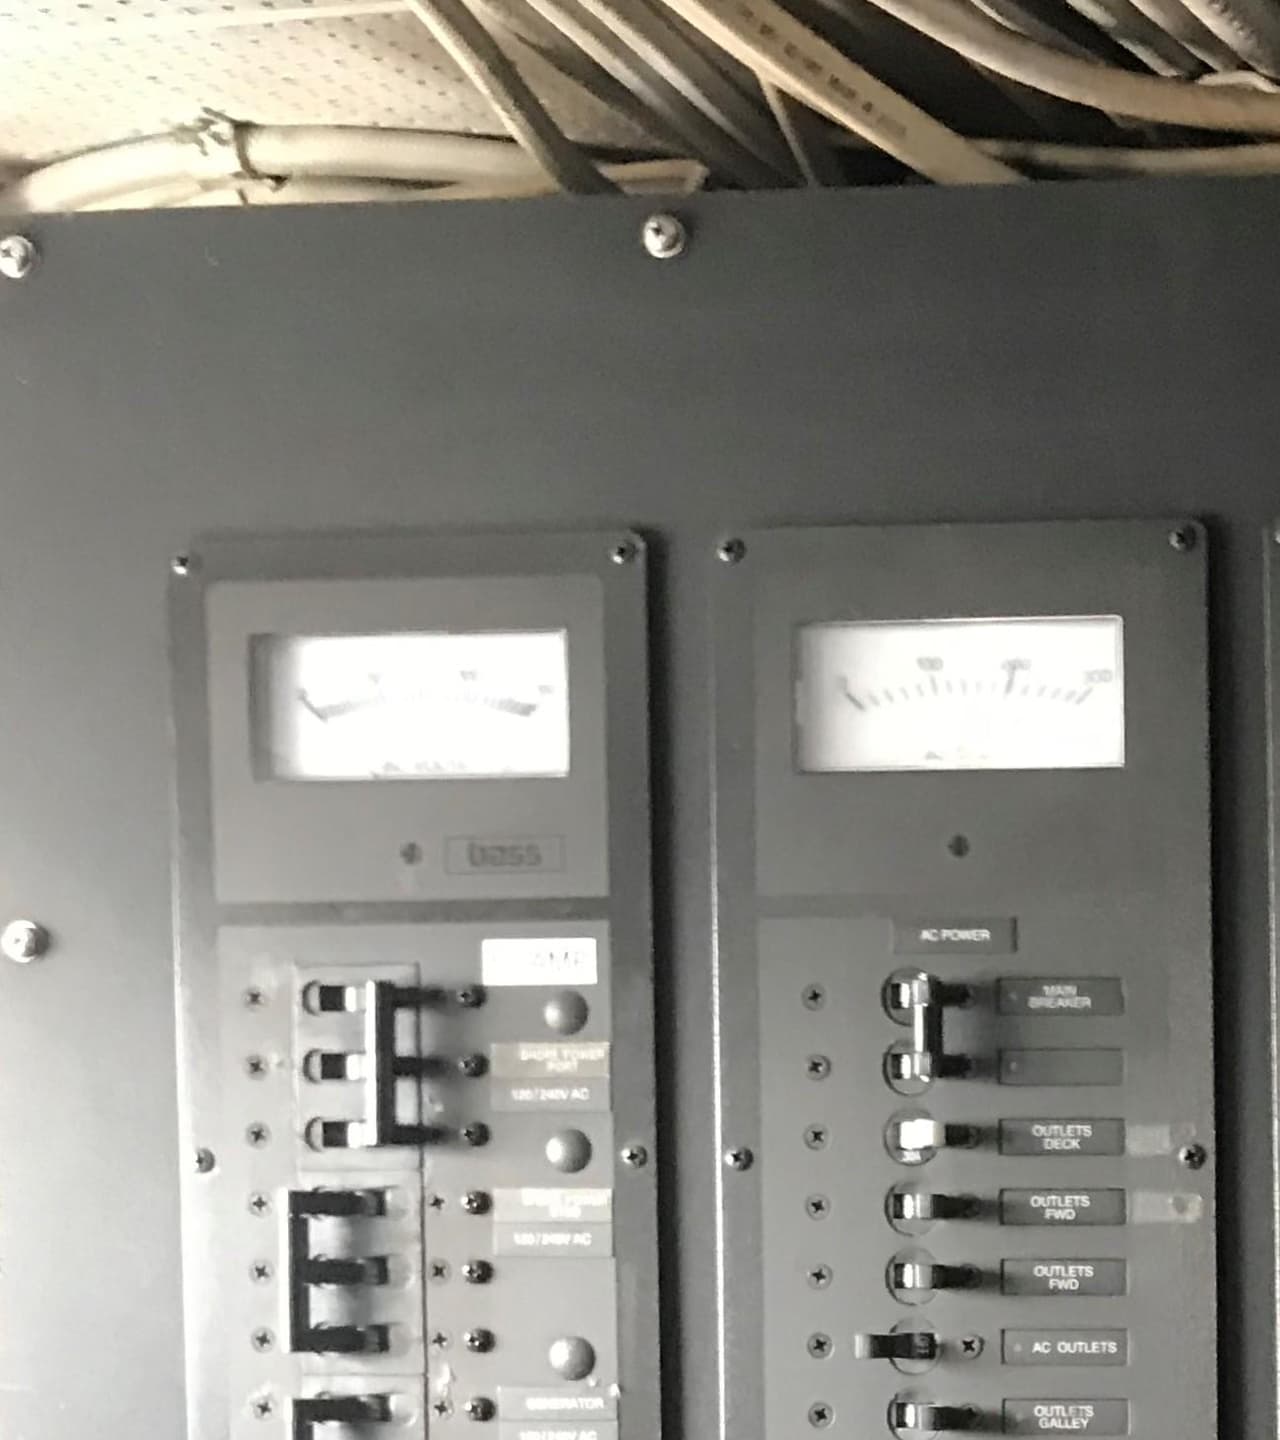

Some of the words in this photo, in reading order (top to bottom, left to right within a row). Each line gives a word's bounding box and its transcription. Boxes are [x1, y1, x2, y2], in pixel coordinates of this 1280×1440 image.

[921, 930, 937, 940] AC
[941, 929, 990, 941] POWER
[1043, 986, 1077, 996] MAIN
[1029, 997, 1091, 1008] BREAKER
[1032, 1125, 1092, 1137] OUTLETS
[1044, 1138, 1080, 1149] DECK
[1031, 1196, 1090, 1208] OUTLETS
[1045, 1209, 1075, 1220] FWD
[1034, 1266, 1093, 1277] OUTLETS
[1049, 1279, 1079, 1290] FWD
[1033, 1342, 1050, 1353] AC
[1057, 1342, 1117, 1354] OUTLETS
[1034, 1406, 1094, 1417] OUTLETS
[1039, 1418, 1090, 1429] GALLEY
